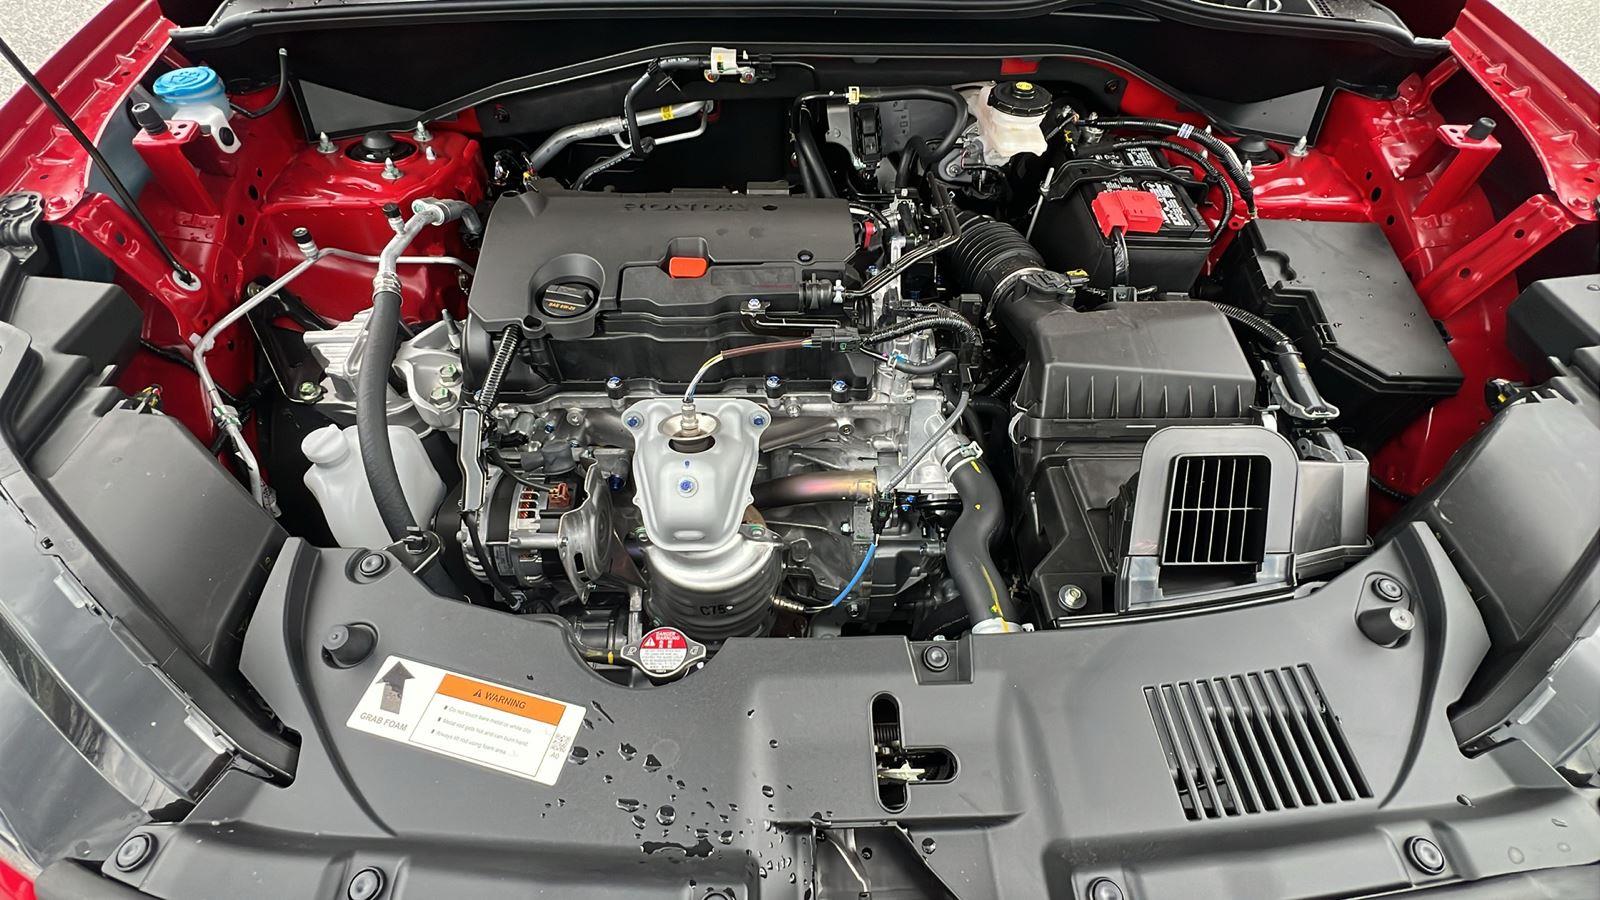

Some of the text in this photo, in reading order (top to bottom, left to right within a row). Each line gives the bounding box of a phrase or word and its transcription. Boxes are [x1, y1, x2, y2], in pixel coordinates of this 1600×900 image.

[485, 692, 527, 710] WARNING
[360, 712, 408, 732] GRAB FOAM
